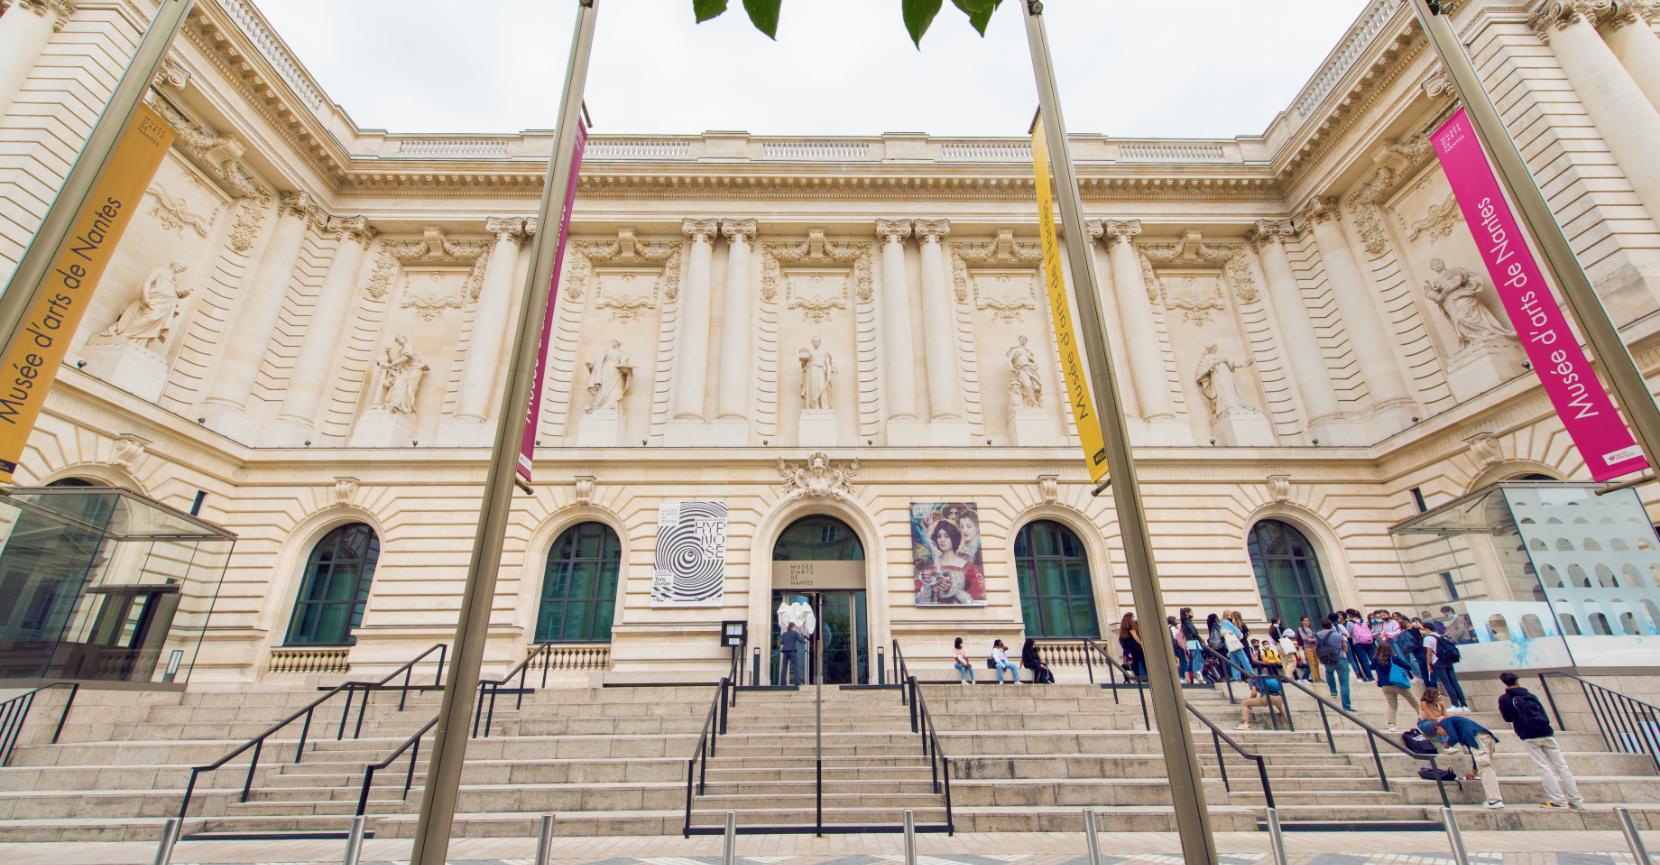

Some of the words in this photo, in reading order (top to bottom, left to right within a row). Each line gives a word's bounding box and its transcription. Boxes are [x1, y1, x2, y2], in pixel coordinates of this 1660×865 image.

[70, 197, 122, 262] Nantes
[1478, 197, 1514, 265] Nantes
[56, 265, 86, 289] de
[1504, 262, 1527, 288] de
[26, 294, 72, 348] d'arts
[1521, 291, 1557, 345] d'arts
[0, 354, 43, 425] Musée
[1068, 351, 1089, 420] Musée
[1550, 349, 1599, 420] Musée
